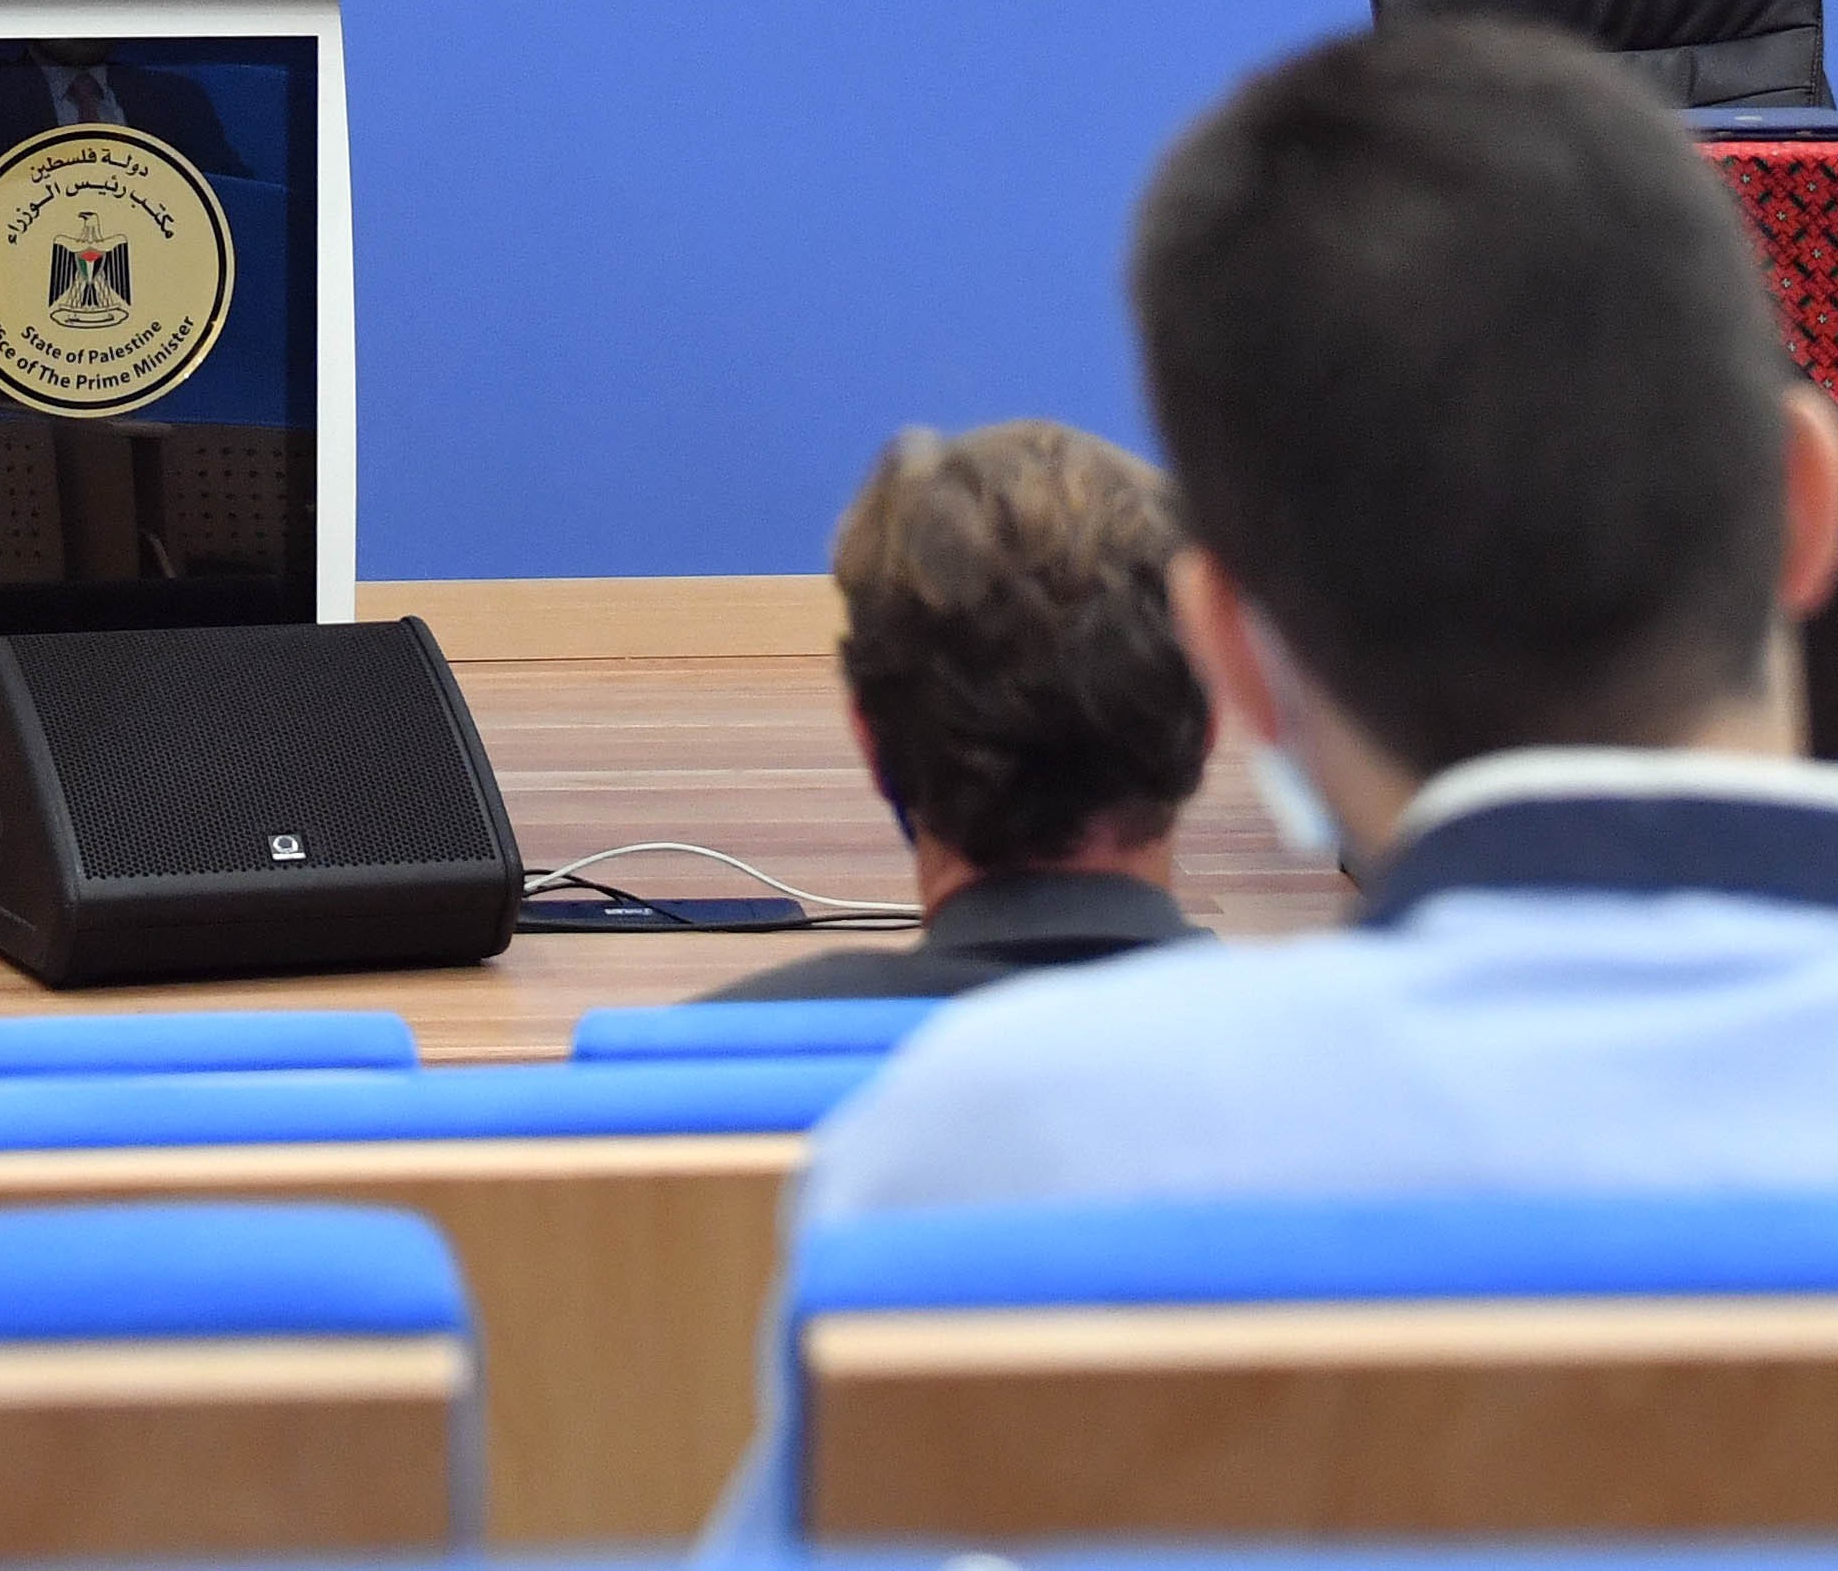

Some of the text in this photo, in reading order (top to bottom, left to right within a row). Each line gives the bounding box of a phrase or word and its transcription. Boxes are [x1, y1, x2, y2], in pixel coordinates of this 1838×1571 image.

[30, 148, 149, 183] دولة فلسطين
[7, 174, 174, 245] مكتب رئيس الوزراء
[16, 357, 39, 374] of
[39, 364, 71, 389] The
[76, 372, 131, 391] Prime
[132, 315, 195, 378] Minister
[21, 319, 162, 365] State of Palestine
